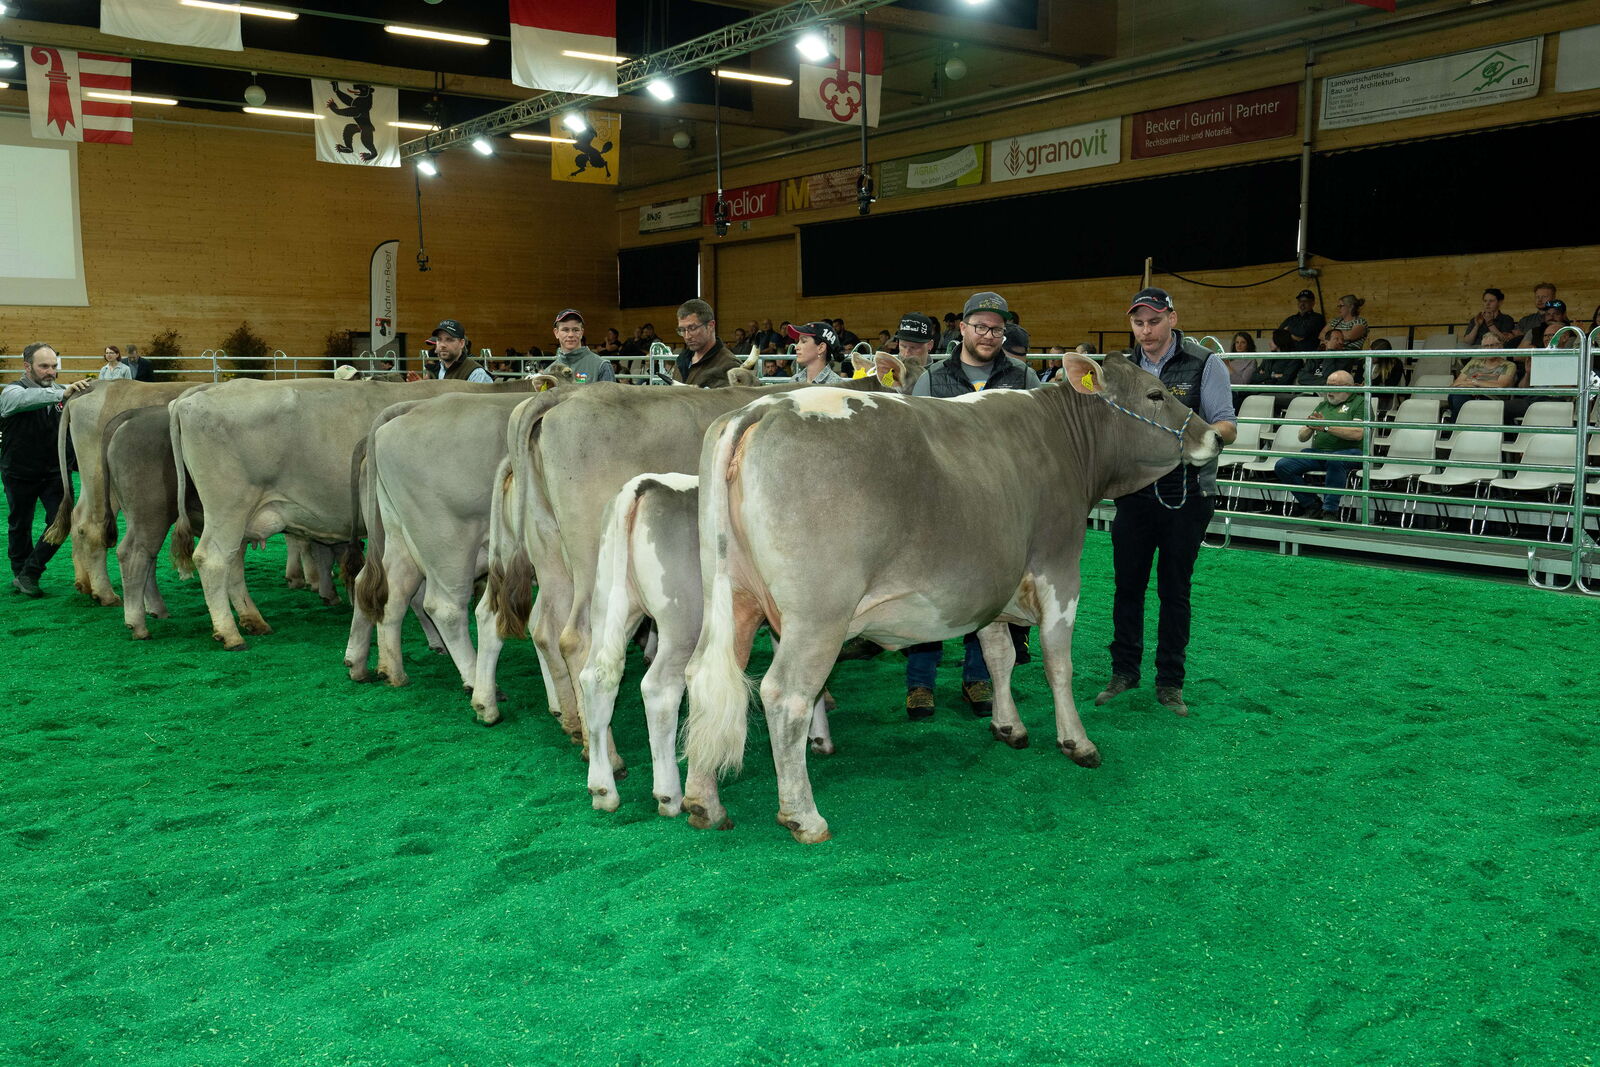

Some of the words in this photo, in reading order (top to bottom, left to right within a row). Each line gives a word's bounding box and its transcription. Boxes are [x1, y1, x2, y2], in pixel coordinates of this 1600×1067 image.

[1331, 71, 1394, 88] Landwirtschaftliches
[1345, 84, 1358, 92] und
[1359, 76, 1411, 90] Architekturbüro
[1511, 76, 1529, 86] LBA
[1145, 117, 1181, 135] Becker
[1190, 107, 1225, 127] Gurini
[1236, 100, 1280, 119] Partner
[1145, 134, 1190, 148] Rechtsanwälte
[1191, 131, 1203, 140] und
[1205, 127, 1232, 139] Notariat
[1026, 128, 1107, 174] granovit
[822, 328, 836, 345] 144
